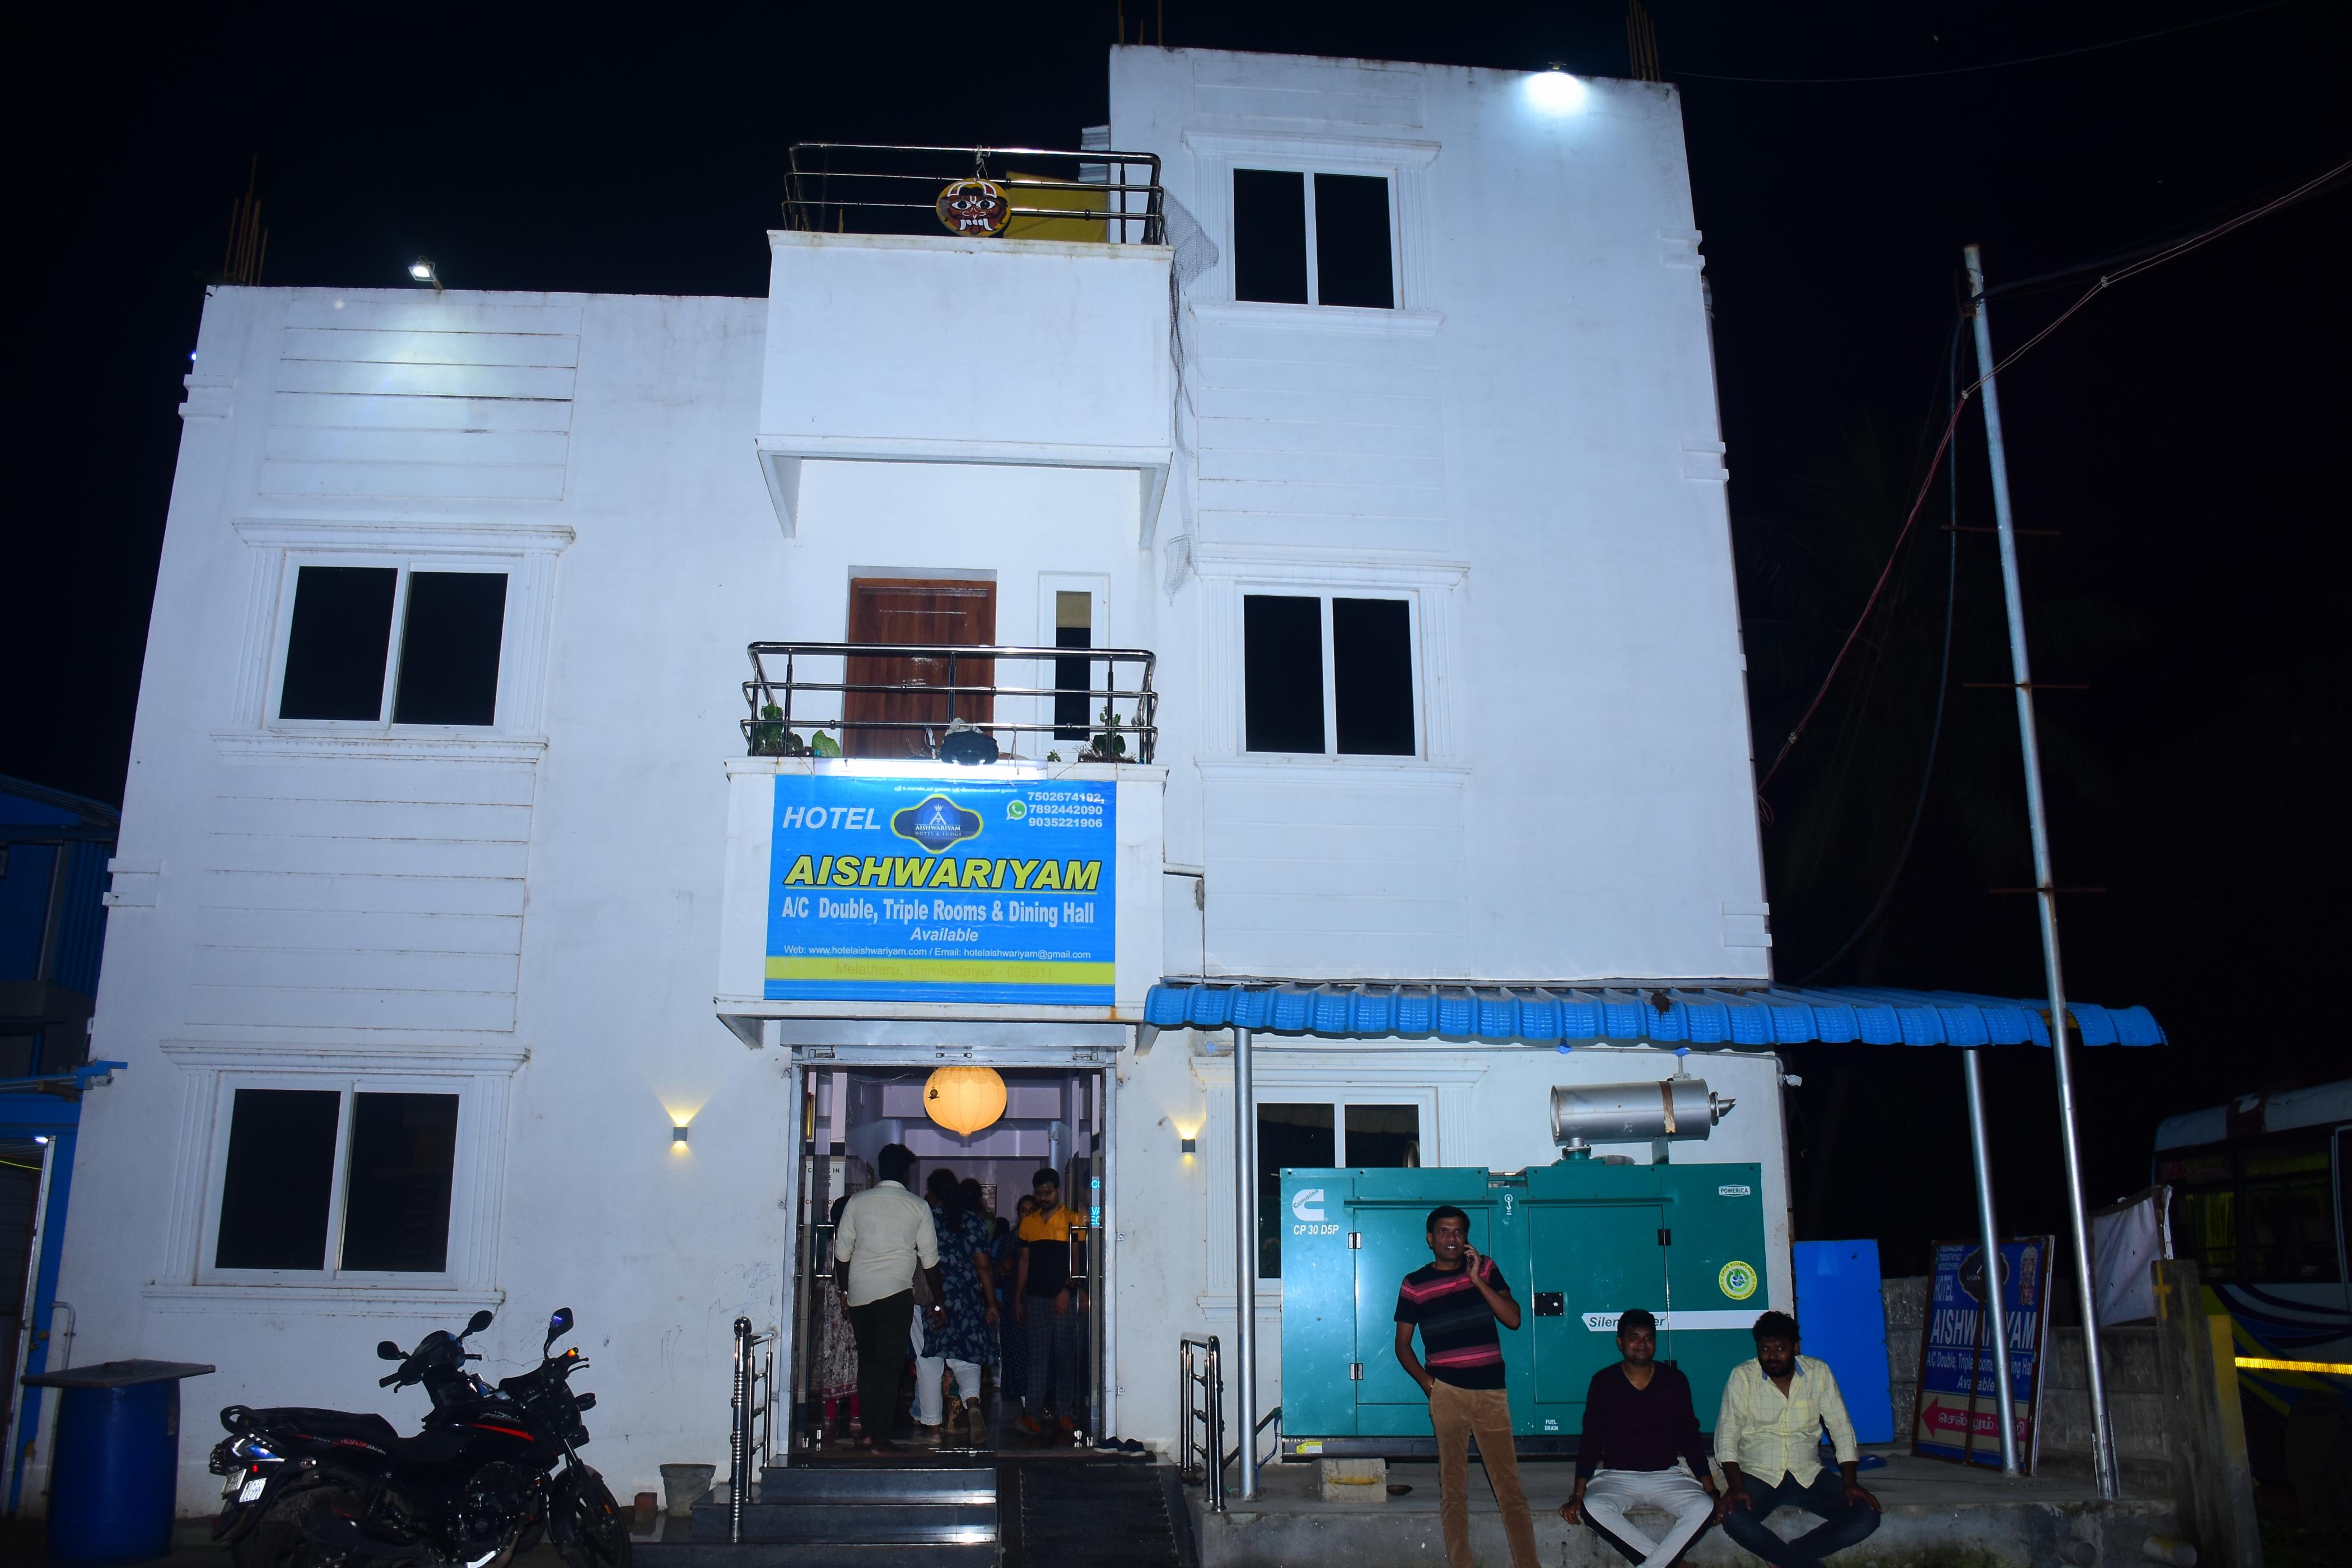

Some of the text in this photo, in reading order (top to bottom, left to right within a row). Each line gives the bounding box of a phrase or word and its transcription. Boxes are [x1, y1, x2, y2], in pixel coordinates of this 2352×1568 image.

[1028, 792, 1105, 804] 7502674192,
[1029, 805, 1103, 815] 7892442090
[782, 807, 881, 830] HOTEL
[1029, 818, 1103, 828] 9035221906
[783, 855, 1102, 891] AISHWARIYAM
[782, 897, 1094, 927] A/C Double, Triple Rooms & Dining Hall
[911, 927, 978, 942] Available
[784, 945, 806, 954] Web:
[809, 946, 927, 957] www.hotelaishwariyam.com
[935, 948, 962, 956] Email:
[964, 949, 1091, 961] hotelaishwariyam@gmail.com
[836, 963, 903, 976] Melatheru,
[909, 964, 995, 979] Thirukadaiyur
[1007, 966, 1053, 978] 609311
[1293, 1189, 1319, 1208] Cummins
[1294, 1225, 1339, 1235] CP 30 D5P
[1733, 1262, 1755, 1276] COMPLIANT
[1933, 1275, 1953, 1301] HOTEL
[1930, 1309, 2037, 1350] AISHWYAM
[1926, 1351, 1936, 1367] A/C
[1936, 1351, 1957, 1371] Double,
[1958, 1352, 1973, 1374] Triple
[1978, 1358, 1994, 1373] ooms
[1957, 1375, 1995, 1392] Avaable
